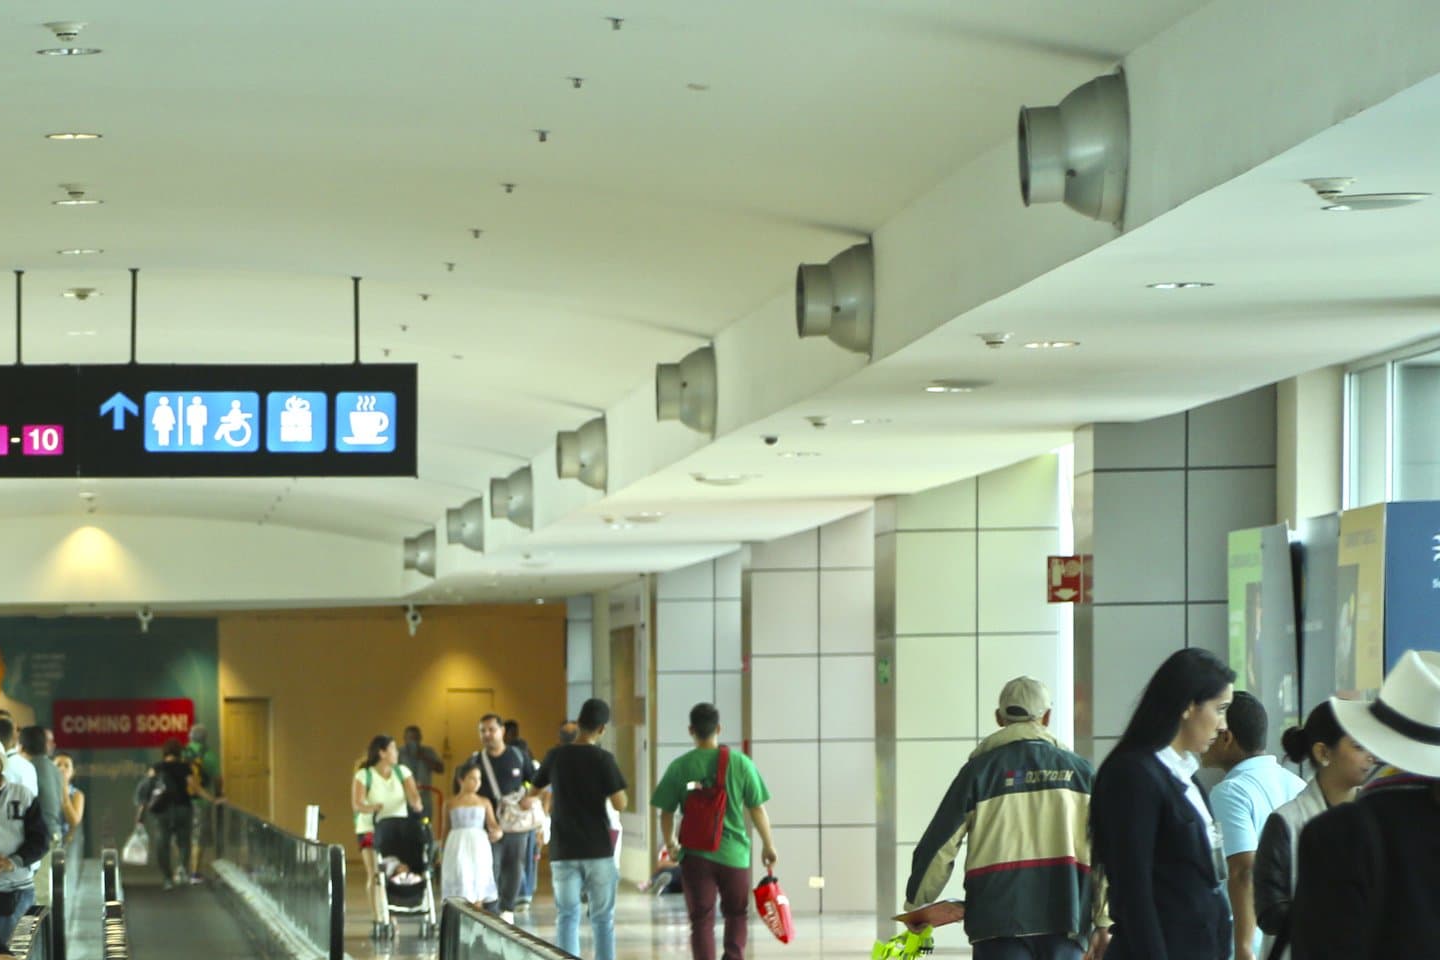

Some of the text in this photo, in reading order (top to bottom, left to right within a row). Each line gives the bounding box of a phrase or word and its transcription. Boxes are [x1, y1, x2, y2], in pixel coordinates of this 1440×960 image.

[28, 428, 59, 451] 10
[62, 714, 188, 733] COMING SOON!
